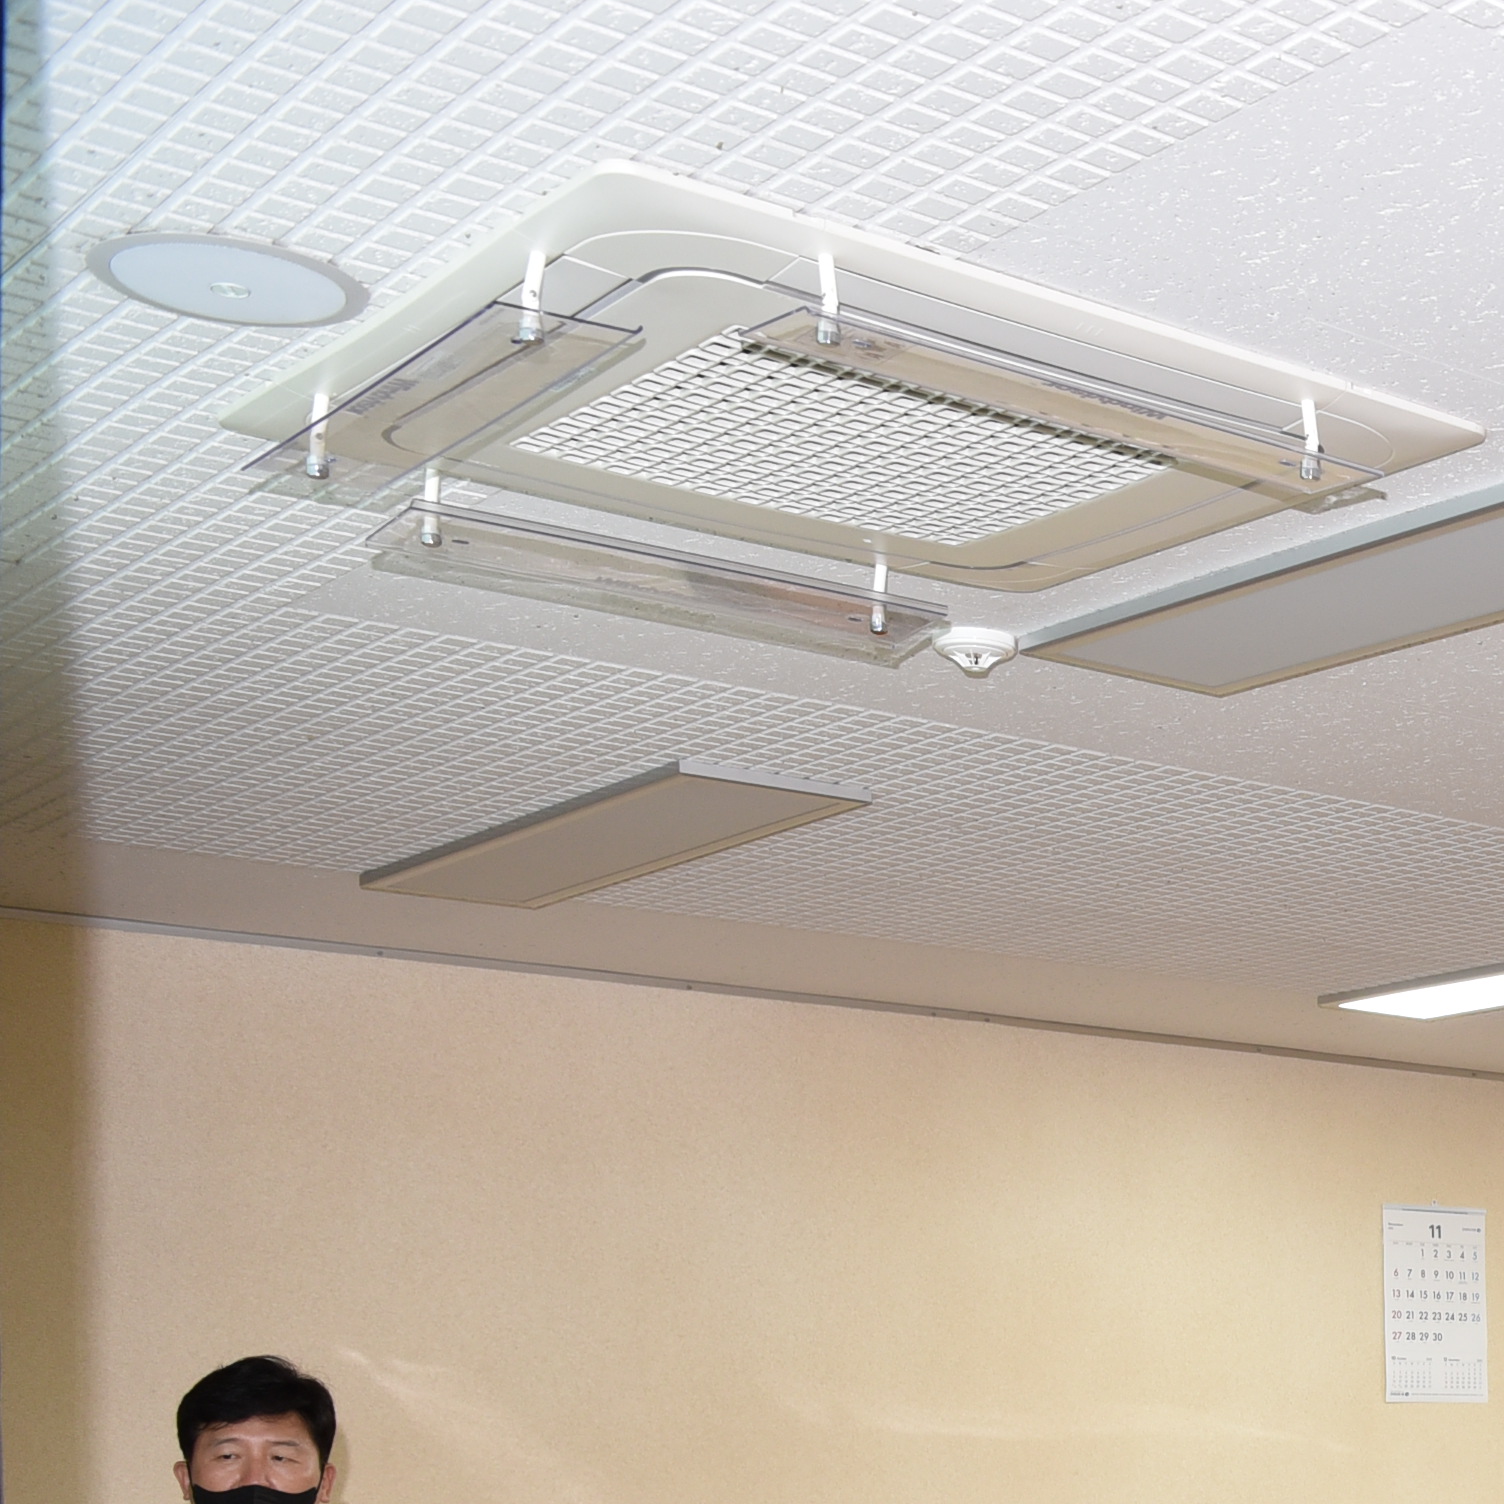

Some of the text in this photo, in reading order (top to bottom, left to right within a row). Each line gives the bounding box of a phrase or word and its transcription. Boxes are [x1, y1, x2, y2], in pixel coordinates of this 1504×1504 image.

[1429, 1224, 1442, 1239] 11
[1445, 1271, 1455, 1280] 10
[1458, 1272, 1466, 1281] 11
[1471, 1272, 1480, 1281] 12
[1392, 1289, 1480, 1302] 13 14 15 16 17 18 19
[1392, 1310, 1481, 1323] 20 21 22 23 24 25 26
[1392, 1331, 1442, 1342] 27 28 29 30
